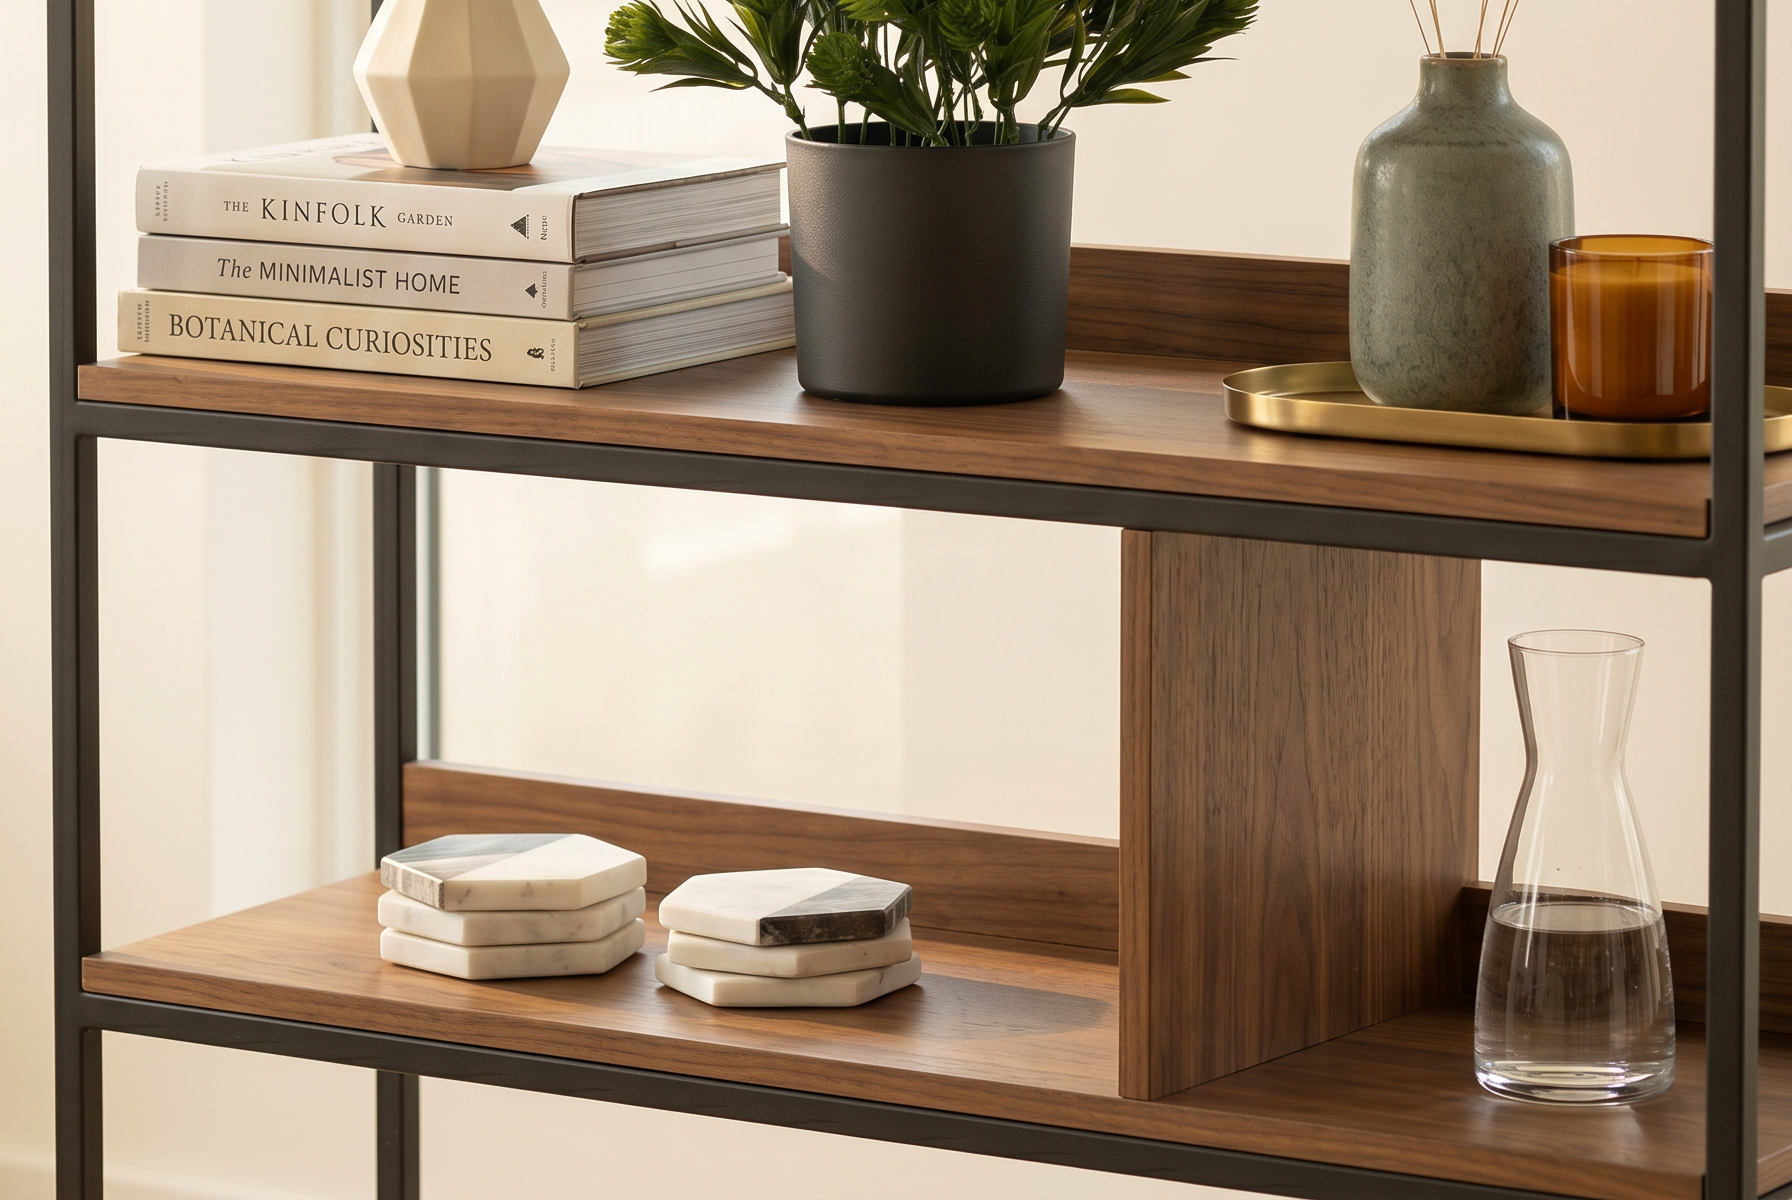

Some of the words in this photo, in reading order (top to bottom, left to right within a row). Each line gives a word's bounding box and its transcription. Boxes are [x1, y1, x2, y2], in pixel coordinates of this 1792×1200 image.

[223, 200, 249, 213] THE
[260, 197, 388, 229] KINFOLK
[397, 212, 453, 227] GARDEN
[217, 257, 252, 279] The
[259, 261, 388, 289] MINIMALIST
[395, 271, 461, 295] HOME
[168, 313, 319, 348] BOTANICAL
[325, 326, 492, 362] CURIOSITIES
